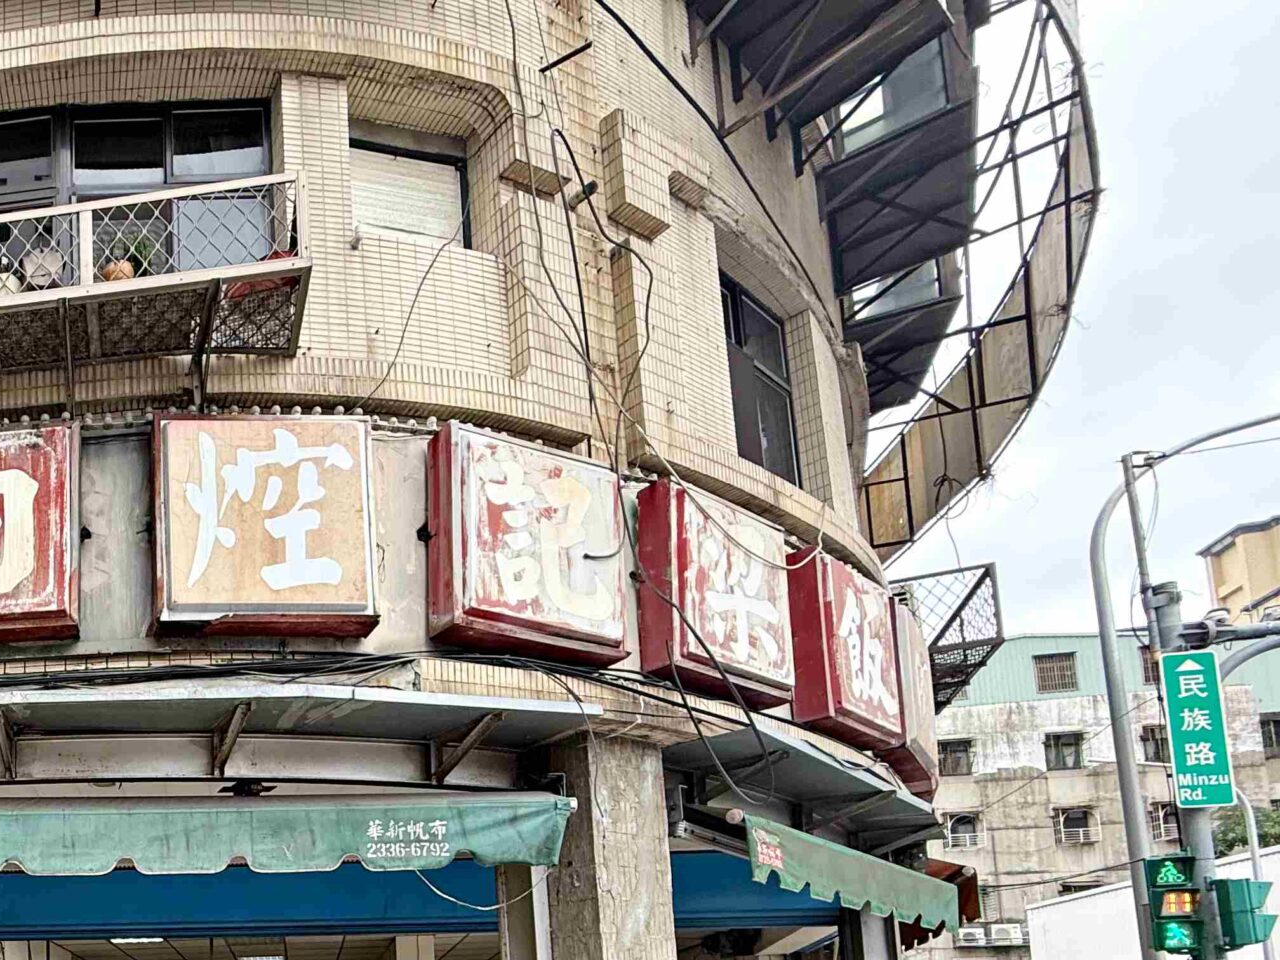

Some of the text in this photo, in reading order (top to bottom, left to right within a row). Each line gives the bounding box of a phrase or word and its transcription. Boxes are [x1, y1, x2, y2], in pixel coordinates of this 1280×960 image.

[1177, 674, 1216, 766] 民族路
[1178, 773, 1229, 787] Minzu
[1180, 788, 1207, 801] Rd.
[366, 819, 448, 841] 華新帆布
[366, 842, 451, 858] 2336-6792
